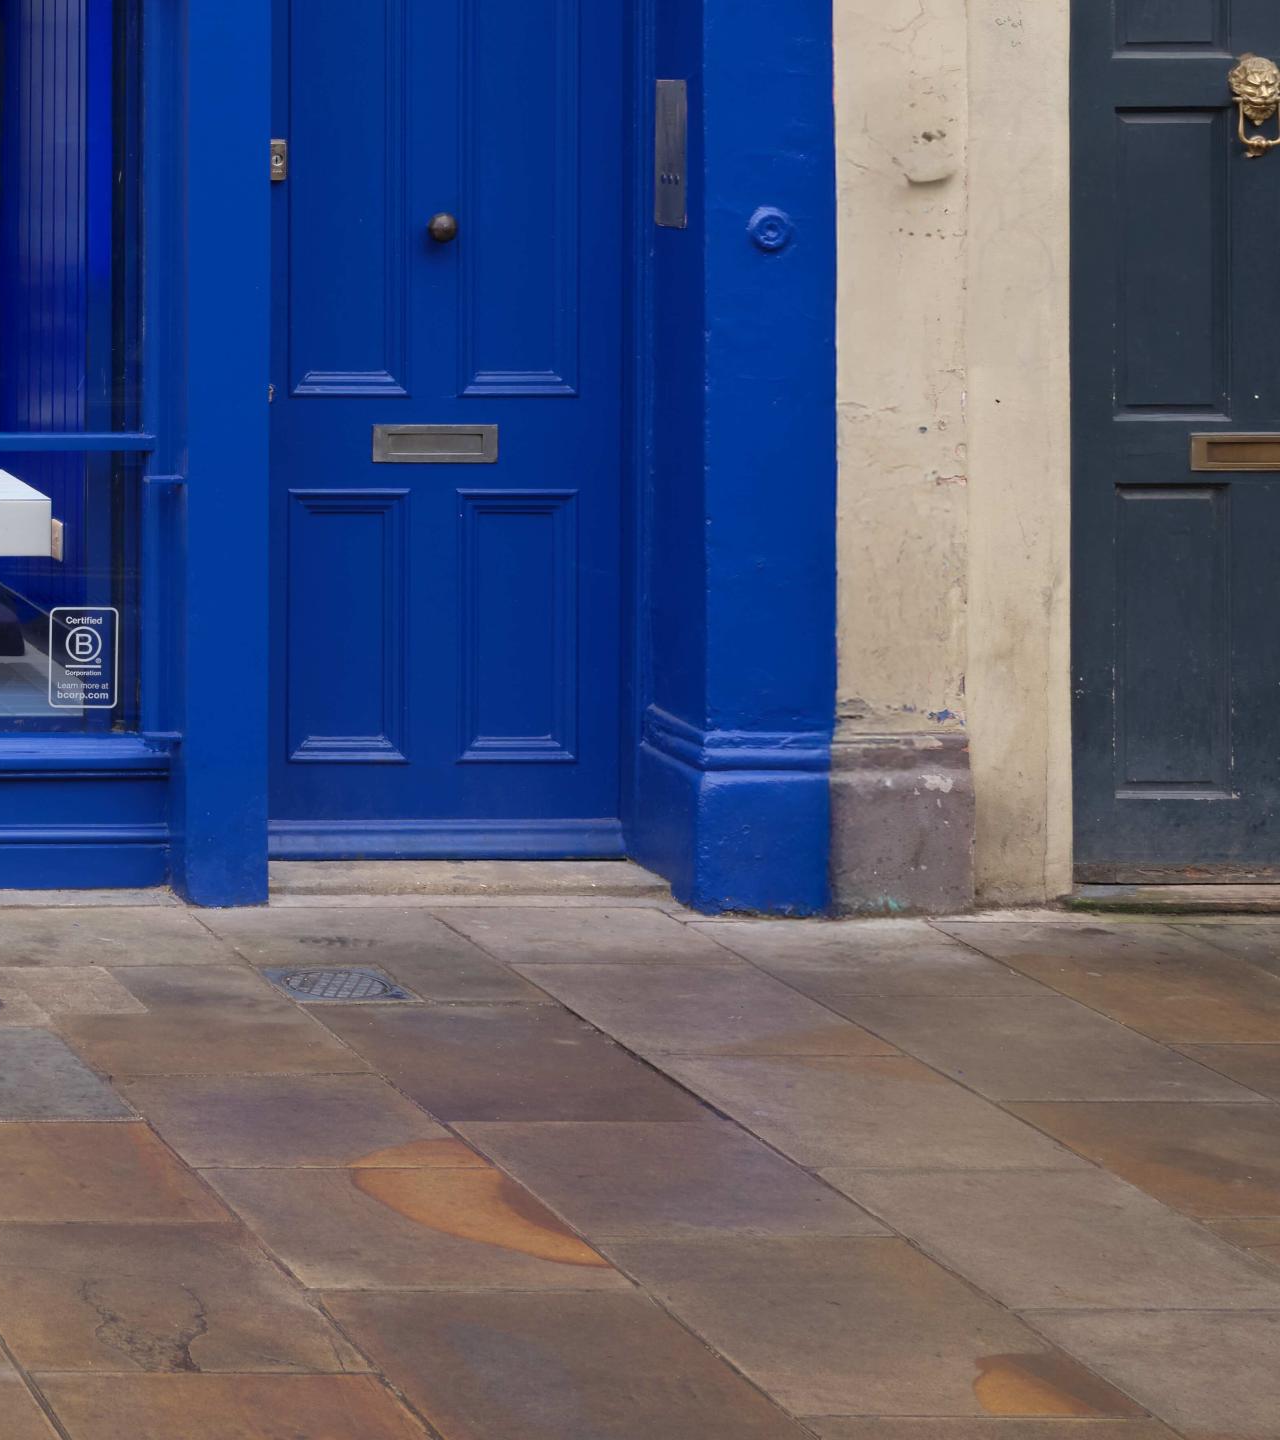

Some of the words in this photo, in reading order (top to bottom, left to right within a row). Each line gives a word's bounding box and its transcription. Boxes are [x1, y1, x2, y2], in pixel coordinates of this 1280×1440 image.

[65, 616, 103, 625] Certified
[75, 634, 92, 655] B
[65, 669, 101, 677] Corporation
[57, 691, 108, 700] bcorp.com
